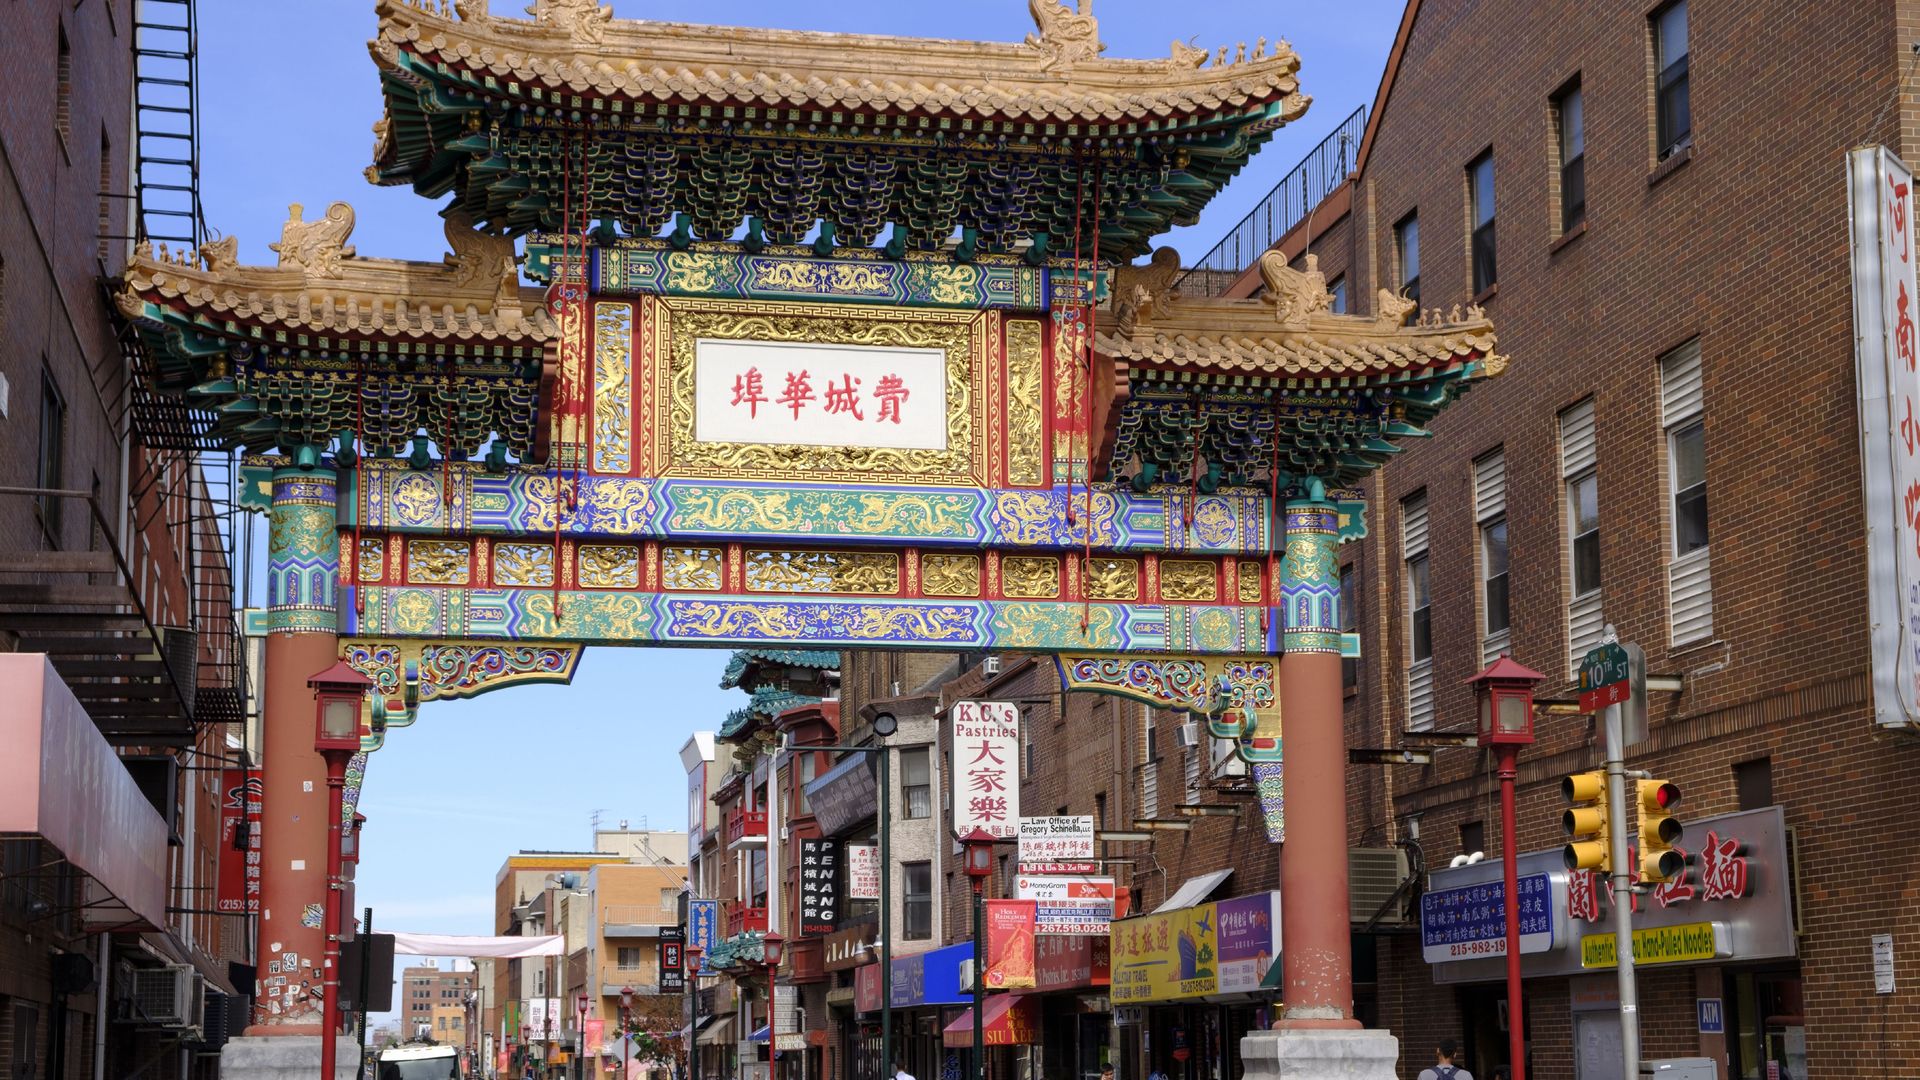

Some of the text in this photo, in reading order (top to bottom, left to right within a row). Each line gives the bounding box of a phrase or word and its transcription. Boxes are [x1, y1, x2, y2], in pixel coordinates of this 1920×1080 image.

[1616, 661, 1627, 678] ST
[958, 704, 1013, 722] K.C.'s
[956, 724, 1017, 738] Pastries
[967, 740, 1008, 822] 大家樂
[1048, 817, 1070, 825] Office
[1071, 817, 1079, 825] of
[1020, 825, 1048, 835] Gregory
[803, 842, 817, 918] 馬來檳城餐館
[820, 842, 834, 921] PENANG
[1041, 924, 1111, 933] 267.519.0204
[1584, 936, 1614, 965] Authentic
[1683, 926, 1713, 955] Noodles
[1117, 1008, 1141, 1021] ATM
[1702, 1002, 1719, 1023] ATM
[987, 1029, 1034, 1043] SIU KEE
